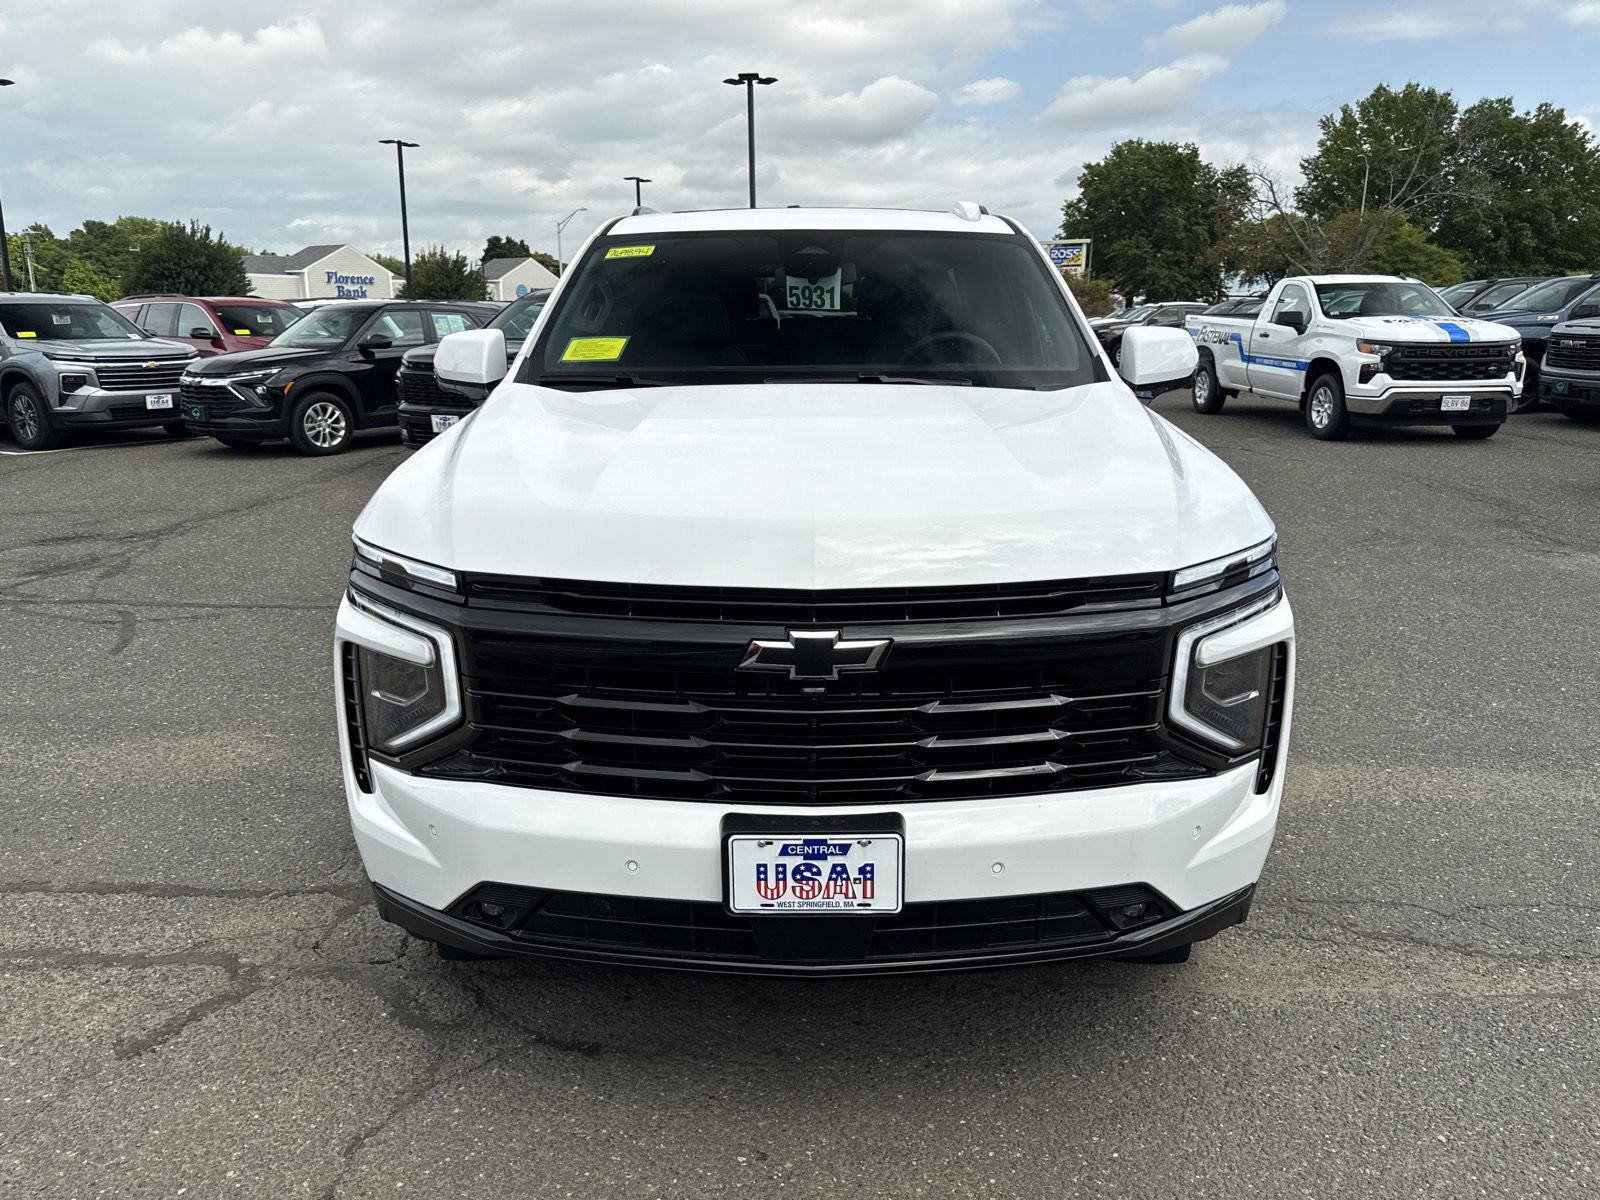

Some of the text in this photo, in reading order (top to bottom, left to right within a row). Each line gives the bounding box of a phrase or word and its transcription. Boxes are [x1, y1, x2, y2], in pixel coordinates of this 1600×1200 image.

[325, 271, 375, 285] Florence
[336, 285, 367, 298] Bank
[789, 285, 836, 308] 5931
[788, 845, 842, 855] CENTRAL
[756, 862, 875, 900] USA-1
[777, 900, 855, 909] WEST SPRINGFIELD, MA
